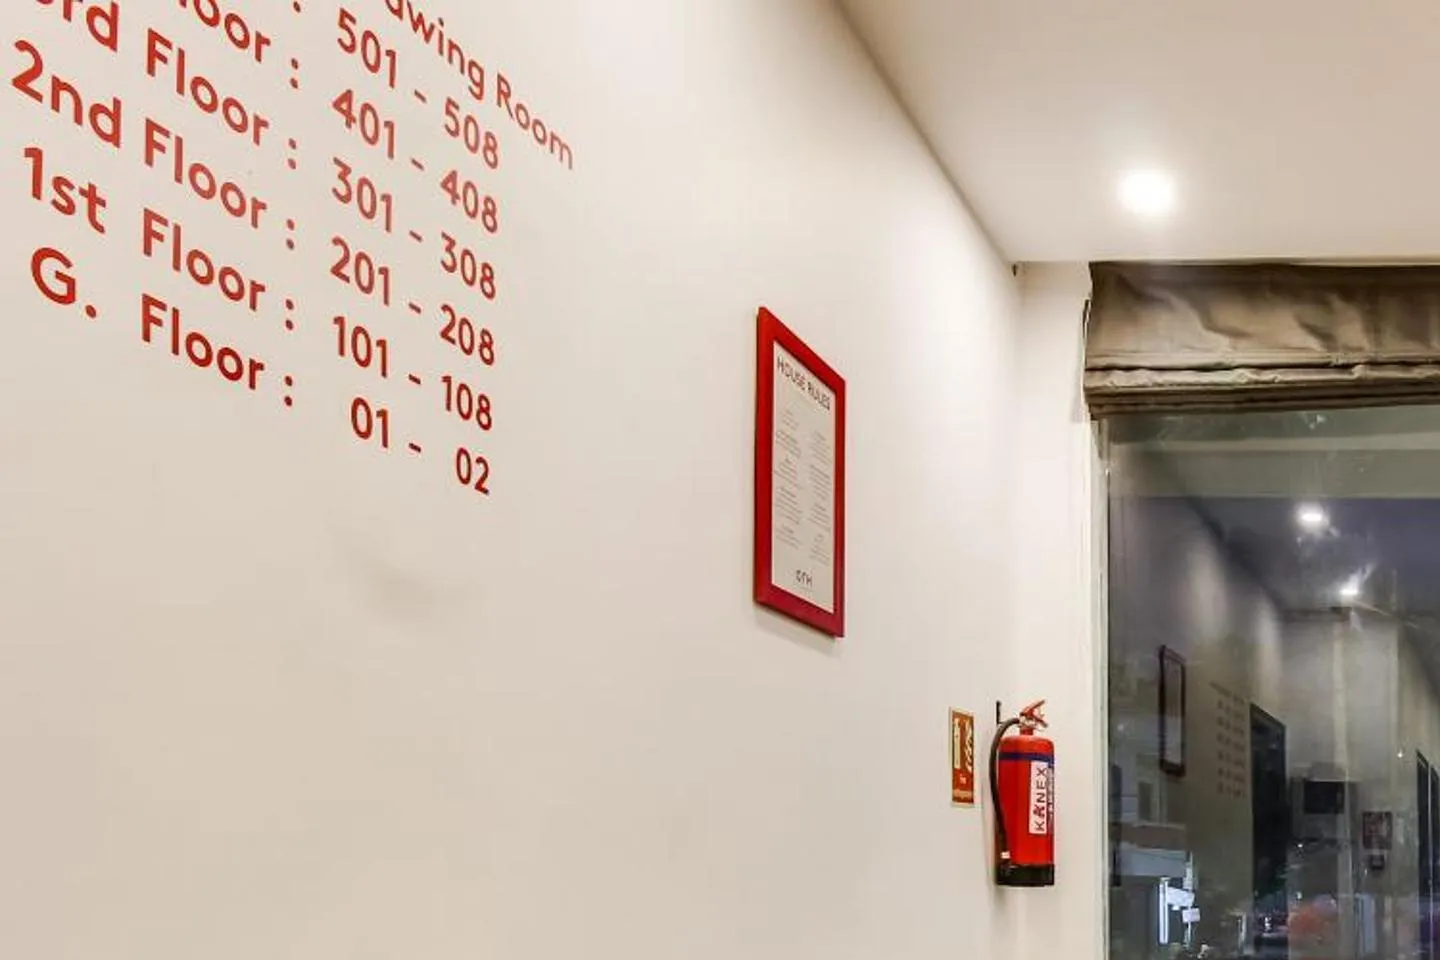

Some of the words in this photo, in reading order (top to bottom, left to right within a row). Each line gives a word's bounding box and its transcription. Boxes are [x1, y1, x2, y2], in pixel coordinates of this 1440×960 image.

[36, 0, 120, 53] rd
[145, 28, 270, 147] Floor
[331, 157, 394, 233] 301
[440, 232, 497, 301] 308
[330, 88, 396, 160] 401
[440, 169, 499, 235] 408
[337, 8, 397, 89] 501
[443, 97, 499, 169] 508
[496, 72, 573, 170] Room
[10, 39, 124, 150] 2nd
[144, 118, 268, 229] Floor
[330, 235, 391, 307] 201
[439, 304, 496, 367] 208
[23, 145, 108, 235] 1st
[141, 208, 267, 311] Floor
[332, 315, 391, 378] 101
[440, 374, 493, 432] 108
[29, 245, 98, 320] G.
[140, 292, 265, 390] Floor
[350, 396, 390, 449] 01
[455, 446, 491, 495] 02
[776, 355, 806, 391] HOUSE
[1033, 767, 1048, 832] KANEX
